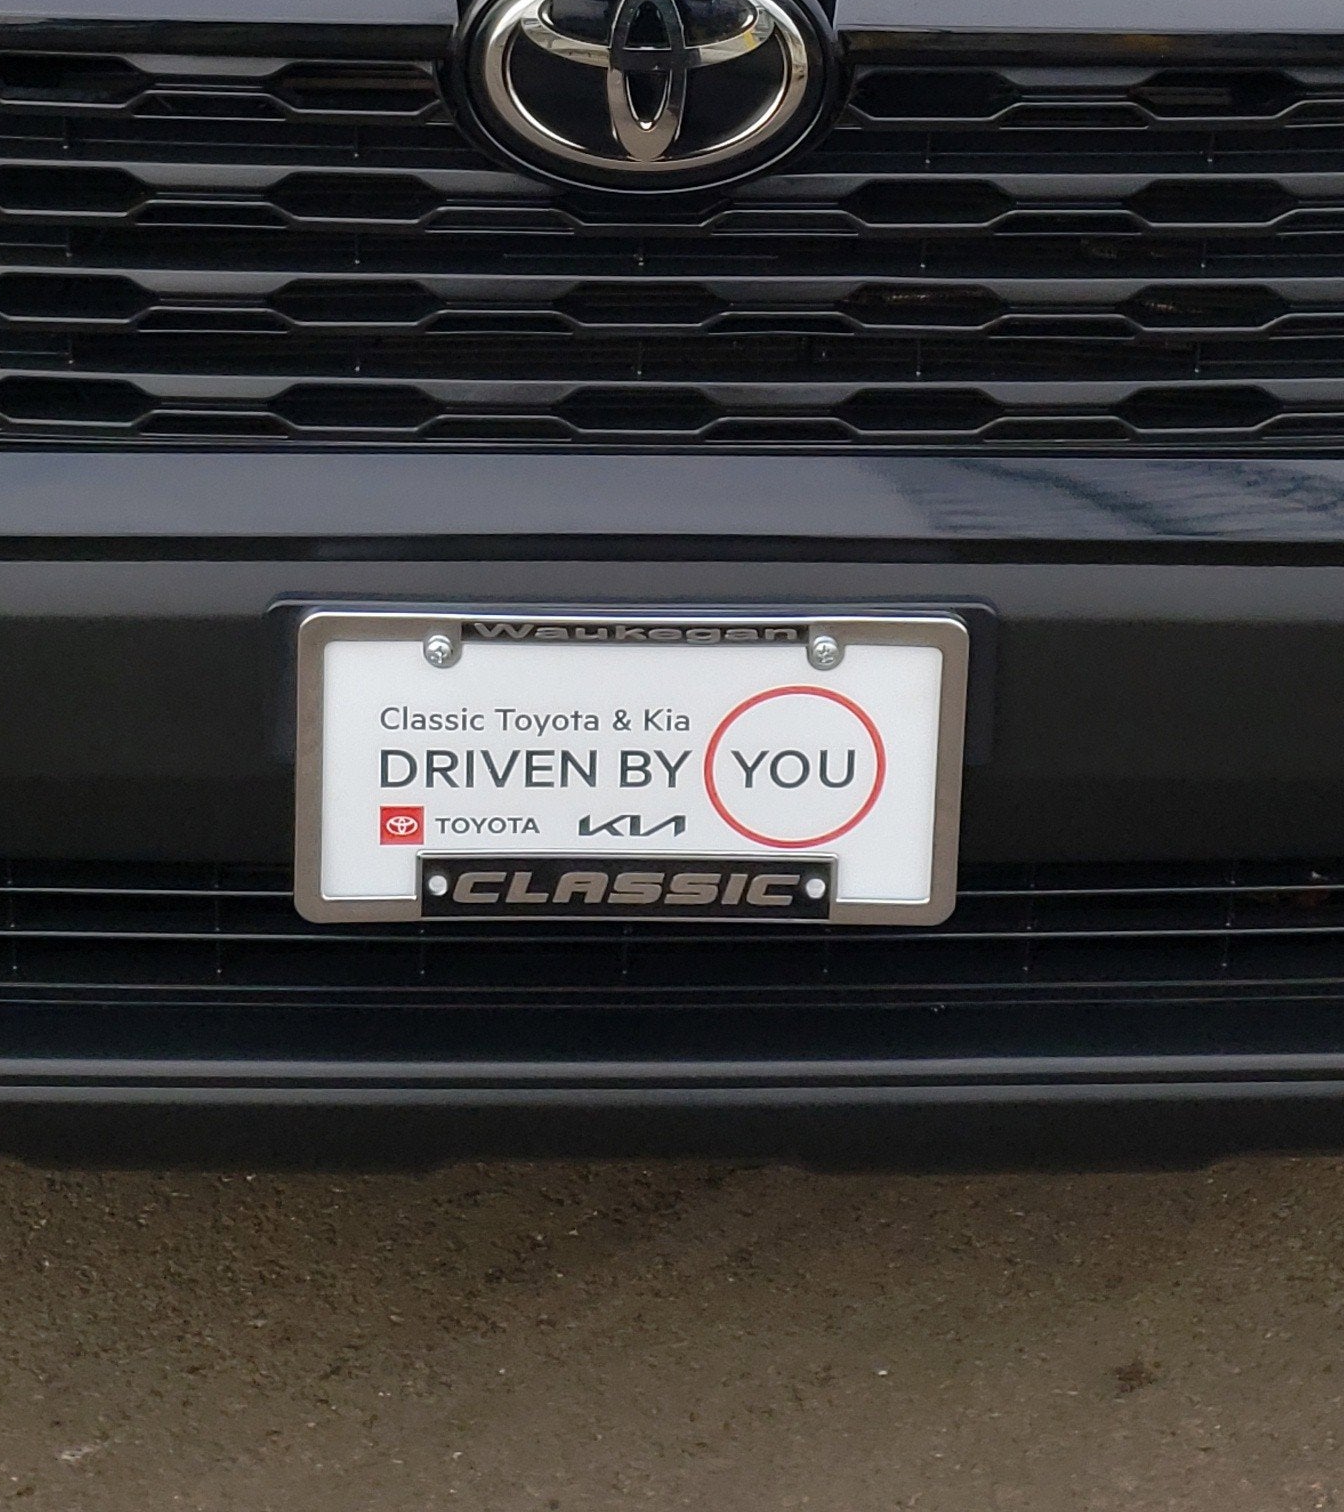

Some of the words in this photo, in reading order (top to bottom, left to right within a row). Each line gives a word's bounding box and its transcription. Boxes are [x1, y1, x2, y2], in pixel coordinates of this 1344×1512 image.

[474, 622, 798, 645] Waukegan
[380, 705, 485, 732] Classic
[494, 708, 600, 738] Toyota
[611, 708, 633, 732] &
[643, 707, 691, 732] Kia
[379, 749, 598, 788] DRIVEN
[619, 749, 693, 789] BY
[730, 749, 856, 789] YOU
[434, 816, 541, 835] TOYOTA
[451, 870, 801, 907] CLASSIC
